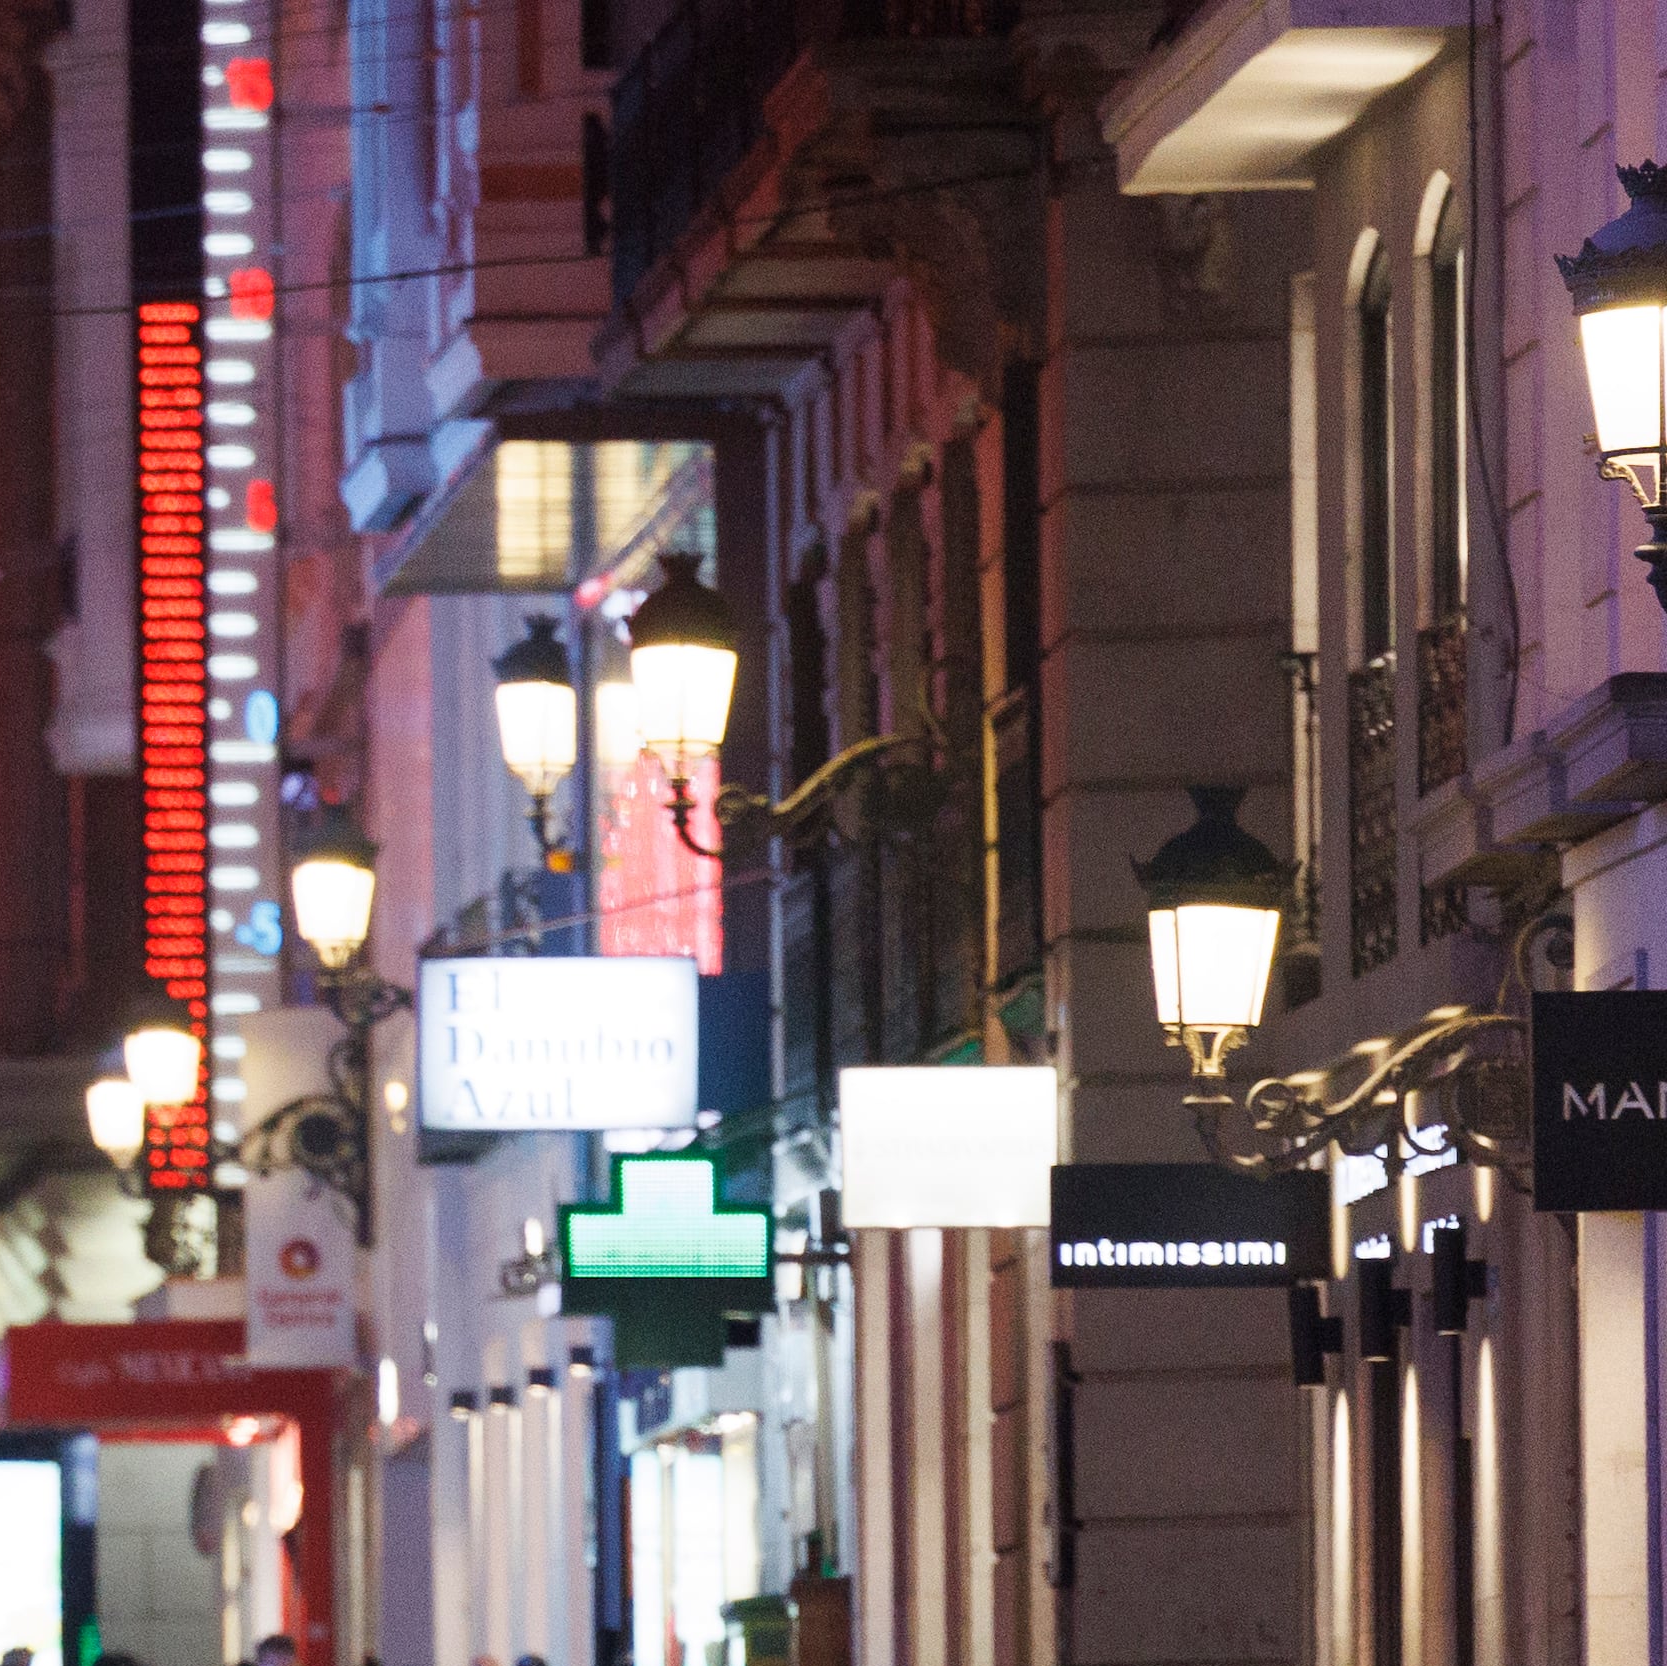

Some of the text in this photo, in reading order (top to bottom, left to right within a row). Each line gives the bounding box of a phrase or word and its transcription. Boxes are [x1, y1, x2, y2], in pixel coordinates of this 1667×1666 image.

[445, 970, 501, 1013] El
[444, 1023, 675, 1065] Danubio
[443, 1077, 576, 1122] Azul
[1561, 1082, 1667, 1121] MA
[1058, 1237, 1287, 1267] intimissimi
